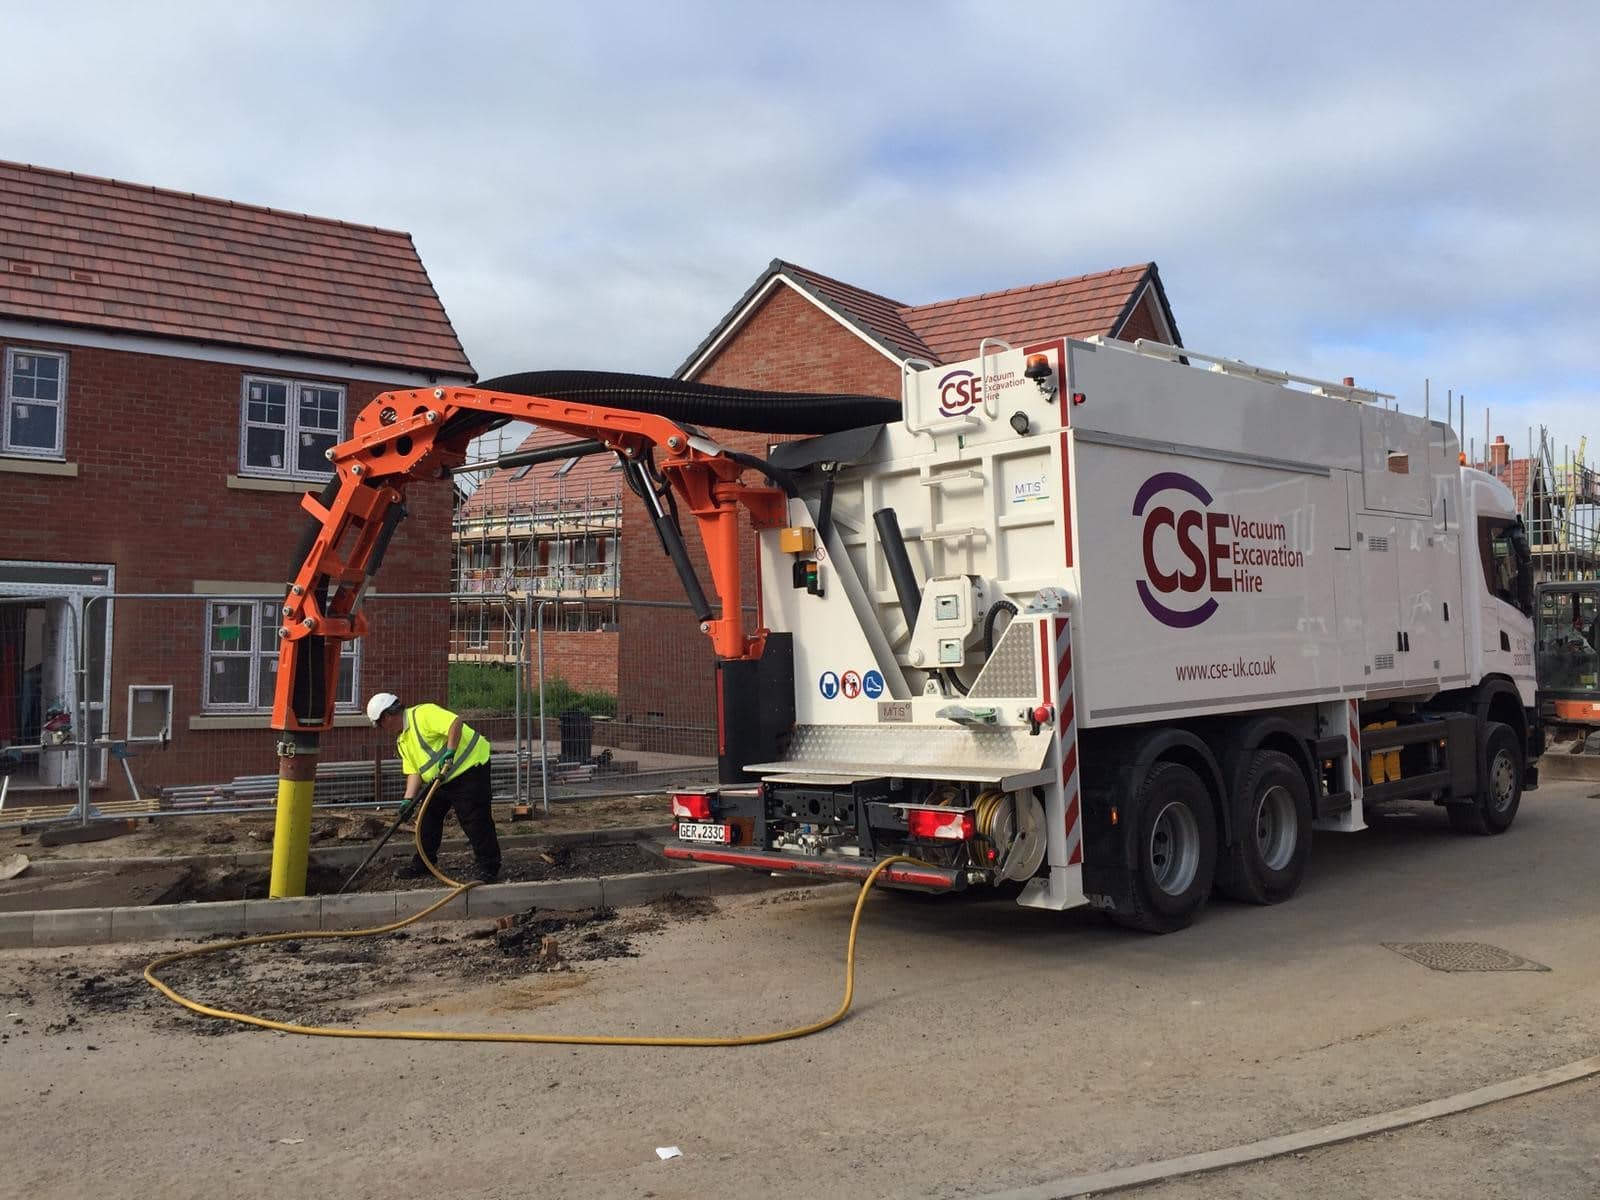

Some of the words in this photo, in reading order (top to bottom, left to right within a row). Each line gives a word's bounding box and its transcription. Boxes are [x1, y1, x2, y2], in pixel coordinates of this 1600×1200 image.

[942, 376, 982, 409] CSE
[1015, 481, 1041, 494] MTS
[1230, 514, 1286, 541] Vacuum
[1142, 506, 1233, 593] CSE
[1232, 541, 1304, 568] Excavation
[1233, 568, 1263, 593] Hire
[1175, 655, 1277, 681] www.cse-uk.co.uk
